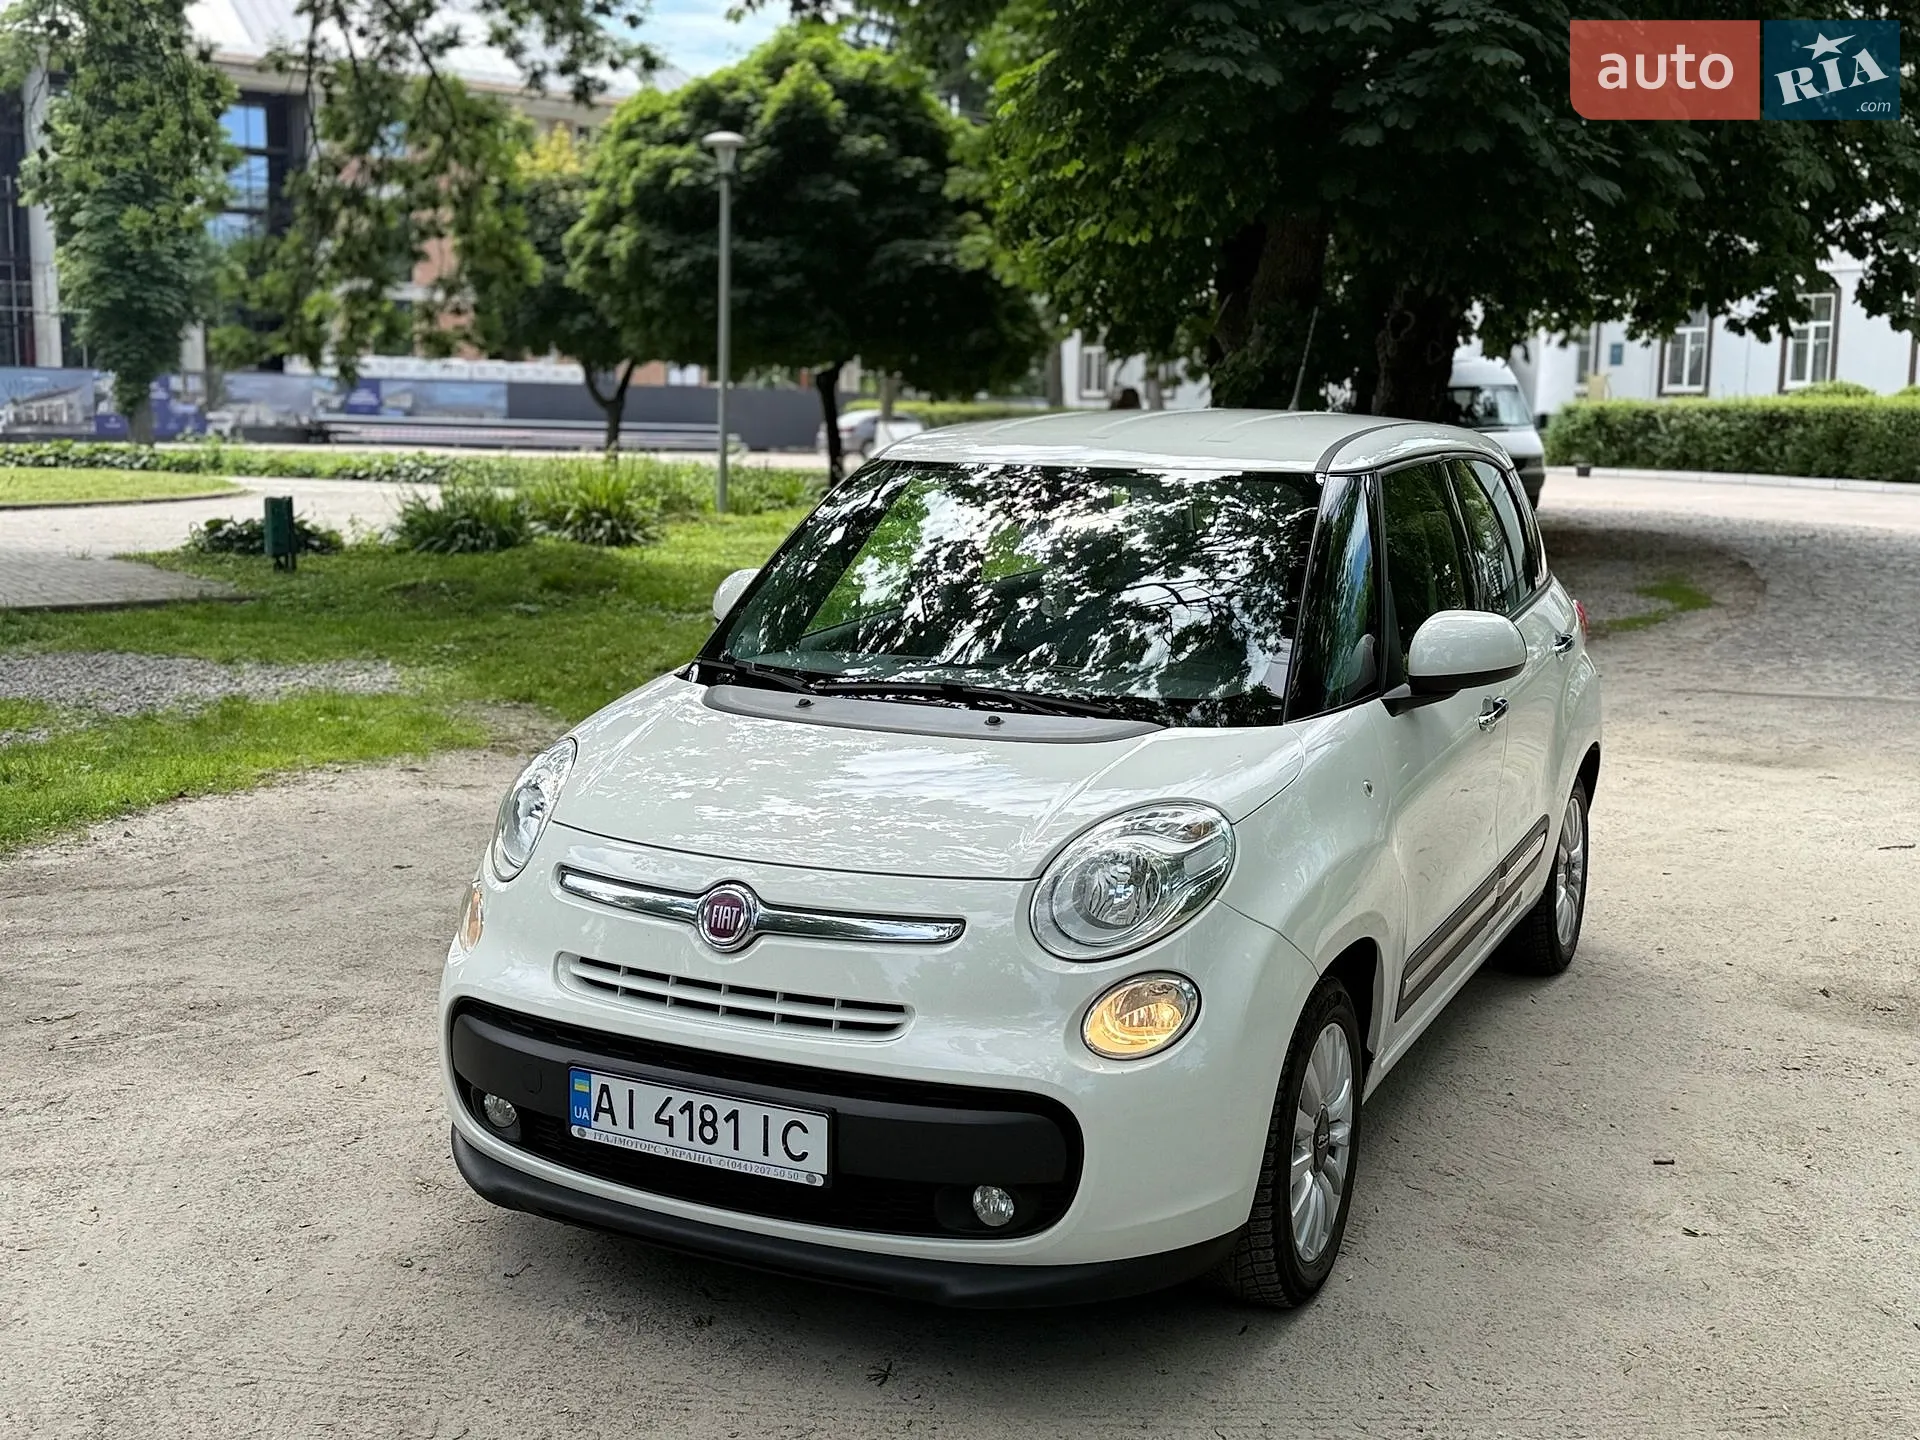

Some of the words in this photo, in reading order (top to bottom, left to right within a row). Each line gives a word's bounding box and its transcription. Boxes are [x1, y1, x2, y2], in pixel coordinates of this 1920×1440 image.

[711, 904, 740, 931] FIAT
[574, 1105, 590, 1121] UA
[592, 1083, 634, 1131] AI
[654, 1096, 740, 1151] 4181
[762, 1114, 809, 1162] IC
